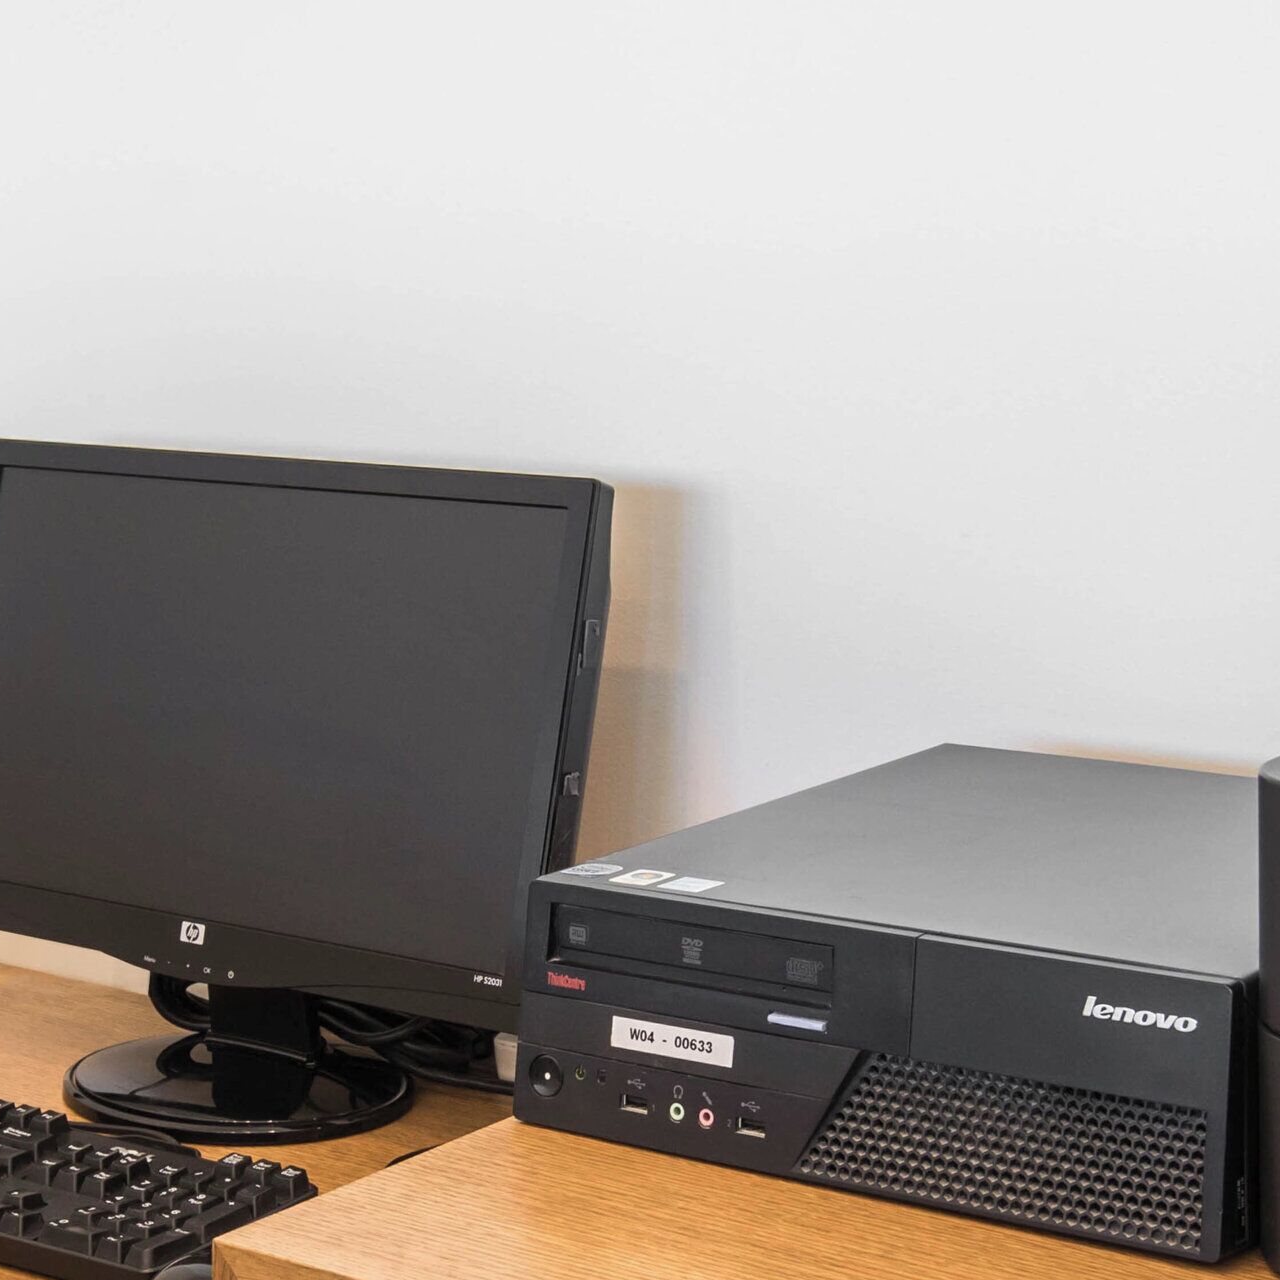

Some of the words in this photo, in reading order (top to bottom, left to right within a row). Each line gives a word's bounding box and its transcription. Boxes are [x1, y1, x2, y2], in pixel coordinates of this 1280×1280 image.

[680, 937, 704, 948] DVD
[473, 974, 483, 983] HP
[483, 976, 503, 987] S2031
[1082, 995, 1198, 1033] lenovo
[629, 1027, 655, 1045] W04
[674, 1036, 713, 1054] 00633
